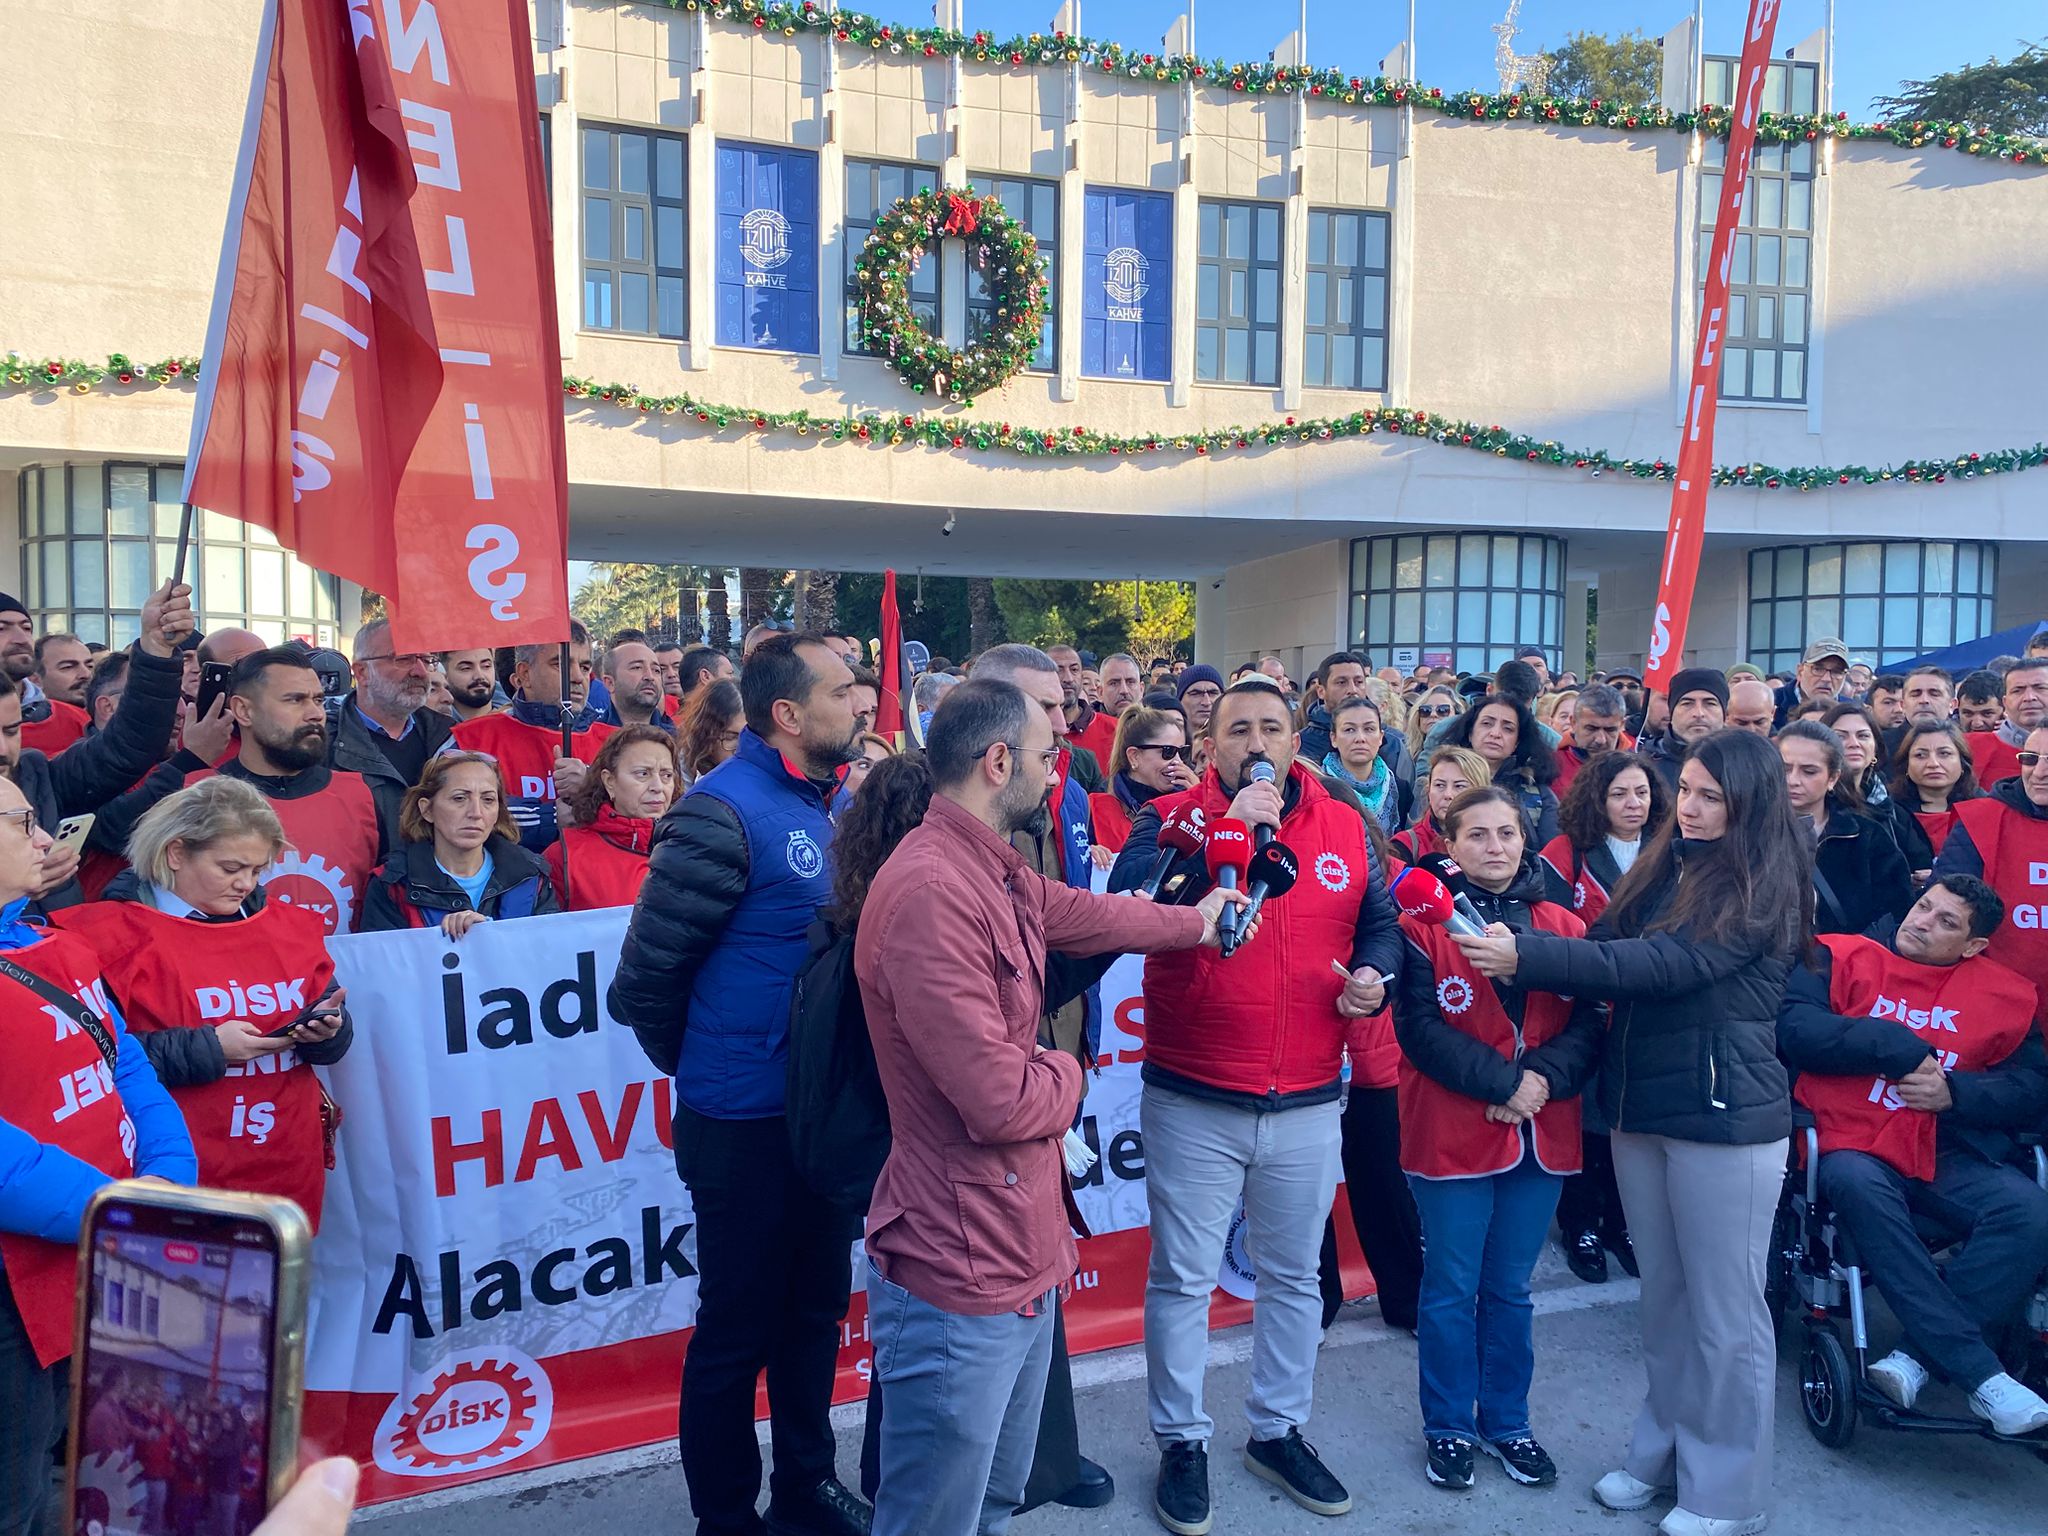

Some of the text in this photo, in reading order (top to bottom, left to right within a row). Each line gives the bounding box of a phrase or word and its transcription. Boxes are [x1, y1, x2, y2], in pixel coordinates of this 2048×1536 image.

[746, 273, 787, 287] KAHVE
[1108, 307, 1144, 321] KAHVE
[1179, 820, 1205, 842] anka
[1214, 831, 1245, 841] NEO
[1280, 857, 1297, 880] İHA
[1322, 864, 1343, 877] DİSK
[195, 978, 305, 1019] DİSK
[442, 951, 600, 1056] İad
[1869, 994, 1961, 1033] DİSK
[80, 1011, 112, 1054] Calvin
[229, 1095, 276, 1145] İŞ
[422, 1398, 504, 1435] DİSK
